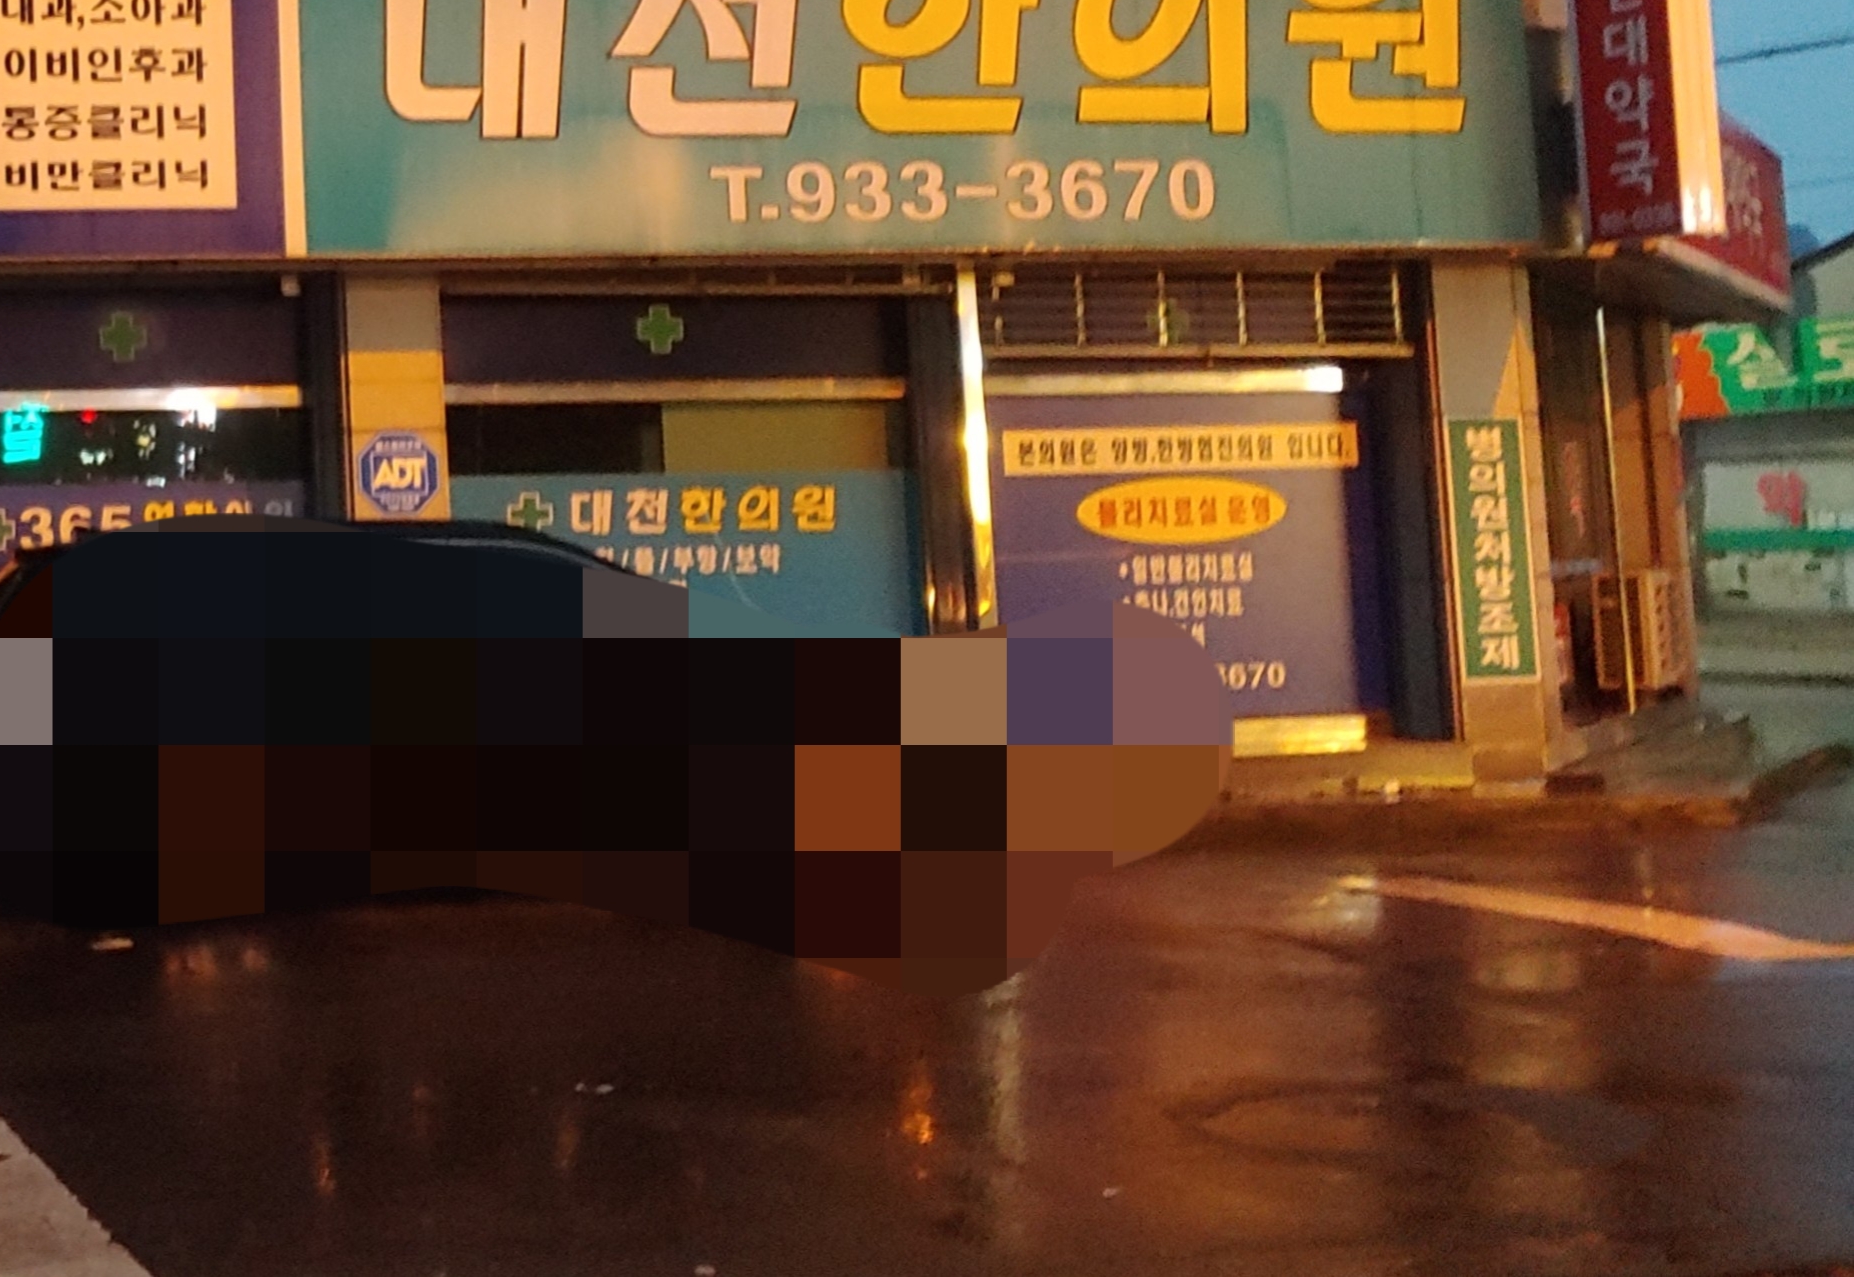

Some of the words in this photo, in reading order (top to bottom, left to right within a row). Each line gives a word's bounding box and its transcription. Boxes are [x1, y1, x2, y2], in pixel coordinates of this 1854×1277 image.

[3, 46, 208, 83] 이비인후과
[1, 103, 206, 141] 통증클리닉
[4, 159, 208, 192] 비만클리닉
[709, 159, 1216, 223] T.933-3670
[373, 456, 426, 490] ADT
[1466, 425, 1521, 671] 병의원처방조제
